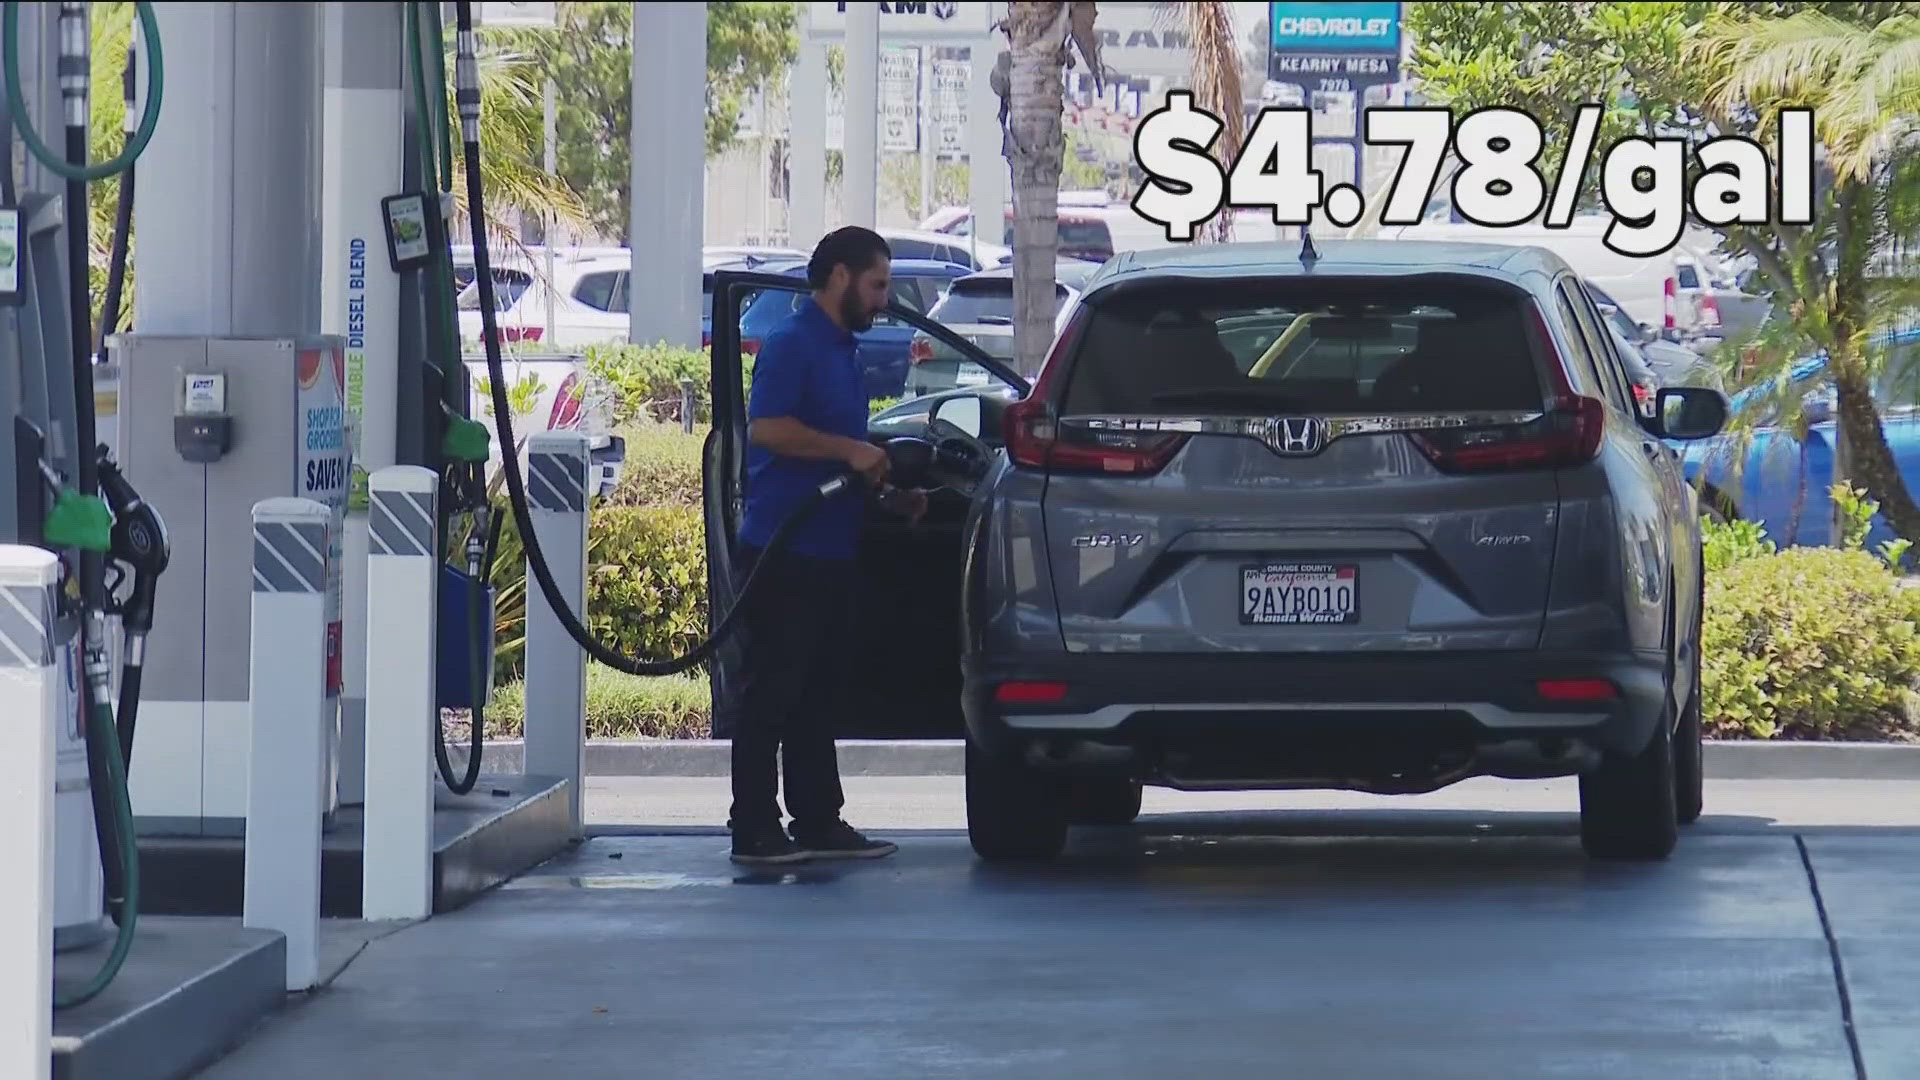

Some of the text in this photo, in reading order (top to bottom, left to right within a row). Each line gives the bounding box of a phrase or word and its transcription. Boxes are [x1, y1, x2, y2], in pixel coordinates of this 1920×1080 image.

[1280, 17, 1391, 36] CHEVROLET
[1093, 29, 1196, 48] RAM
[1280, 57, 1389, 73] KEARNY MESA
[350, 238, 365, 289] BLEND
[349, 295, 364, 349] DIESEL
[307, 407, 329, 429] SHOP
[306, 457, 336, 492] SAVE
[1072, 534, 1143, 547] CR-V
[1267, 564, 1333, 573] ORANGE COUNTY
[1247, 585, 1351, 614] 9AYB010
[1253, 612, 1298, 623] Honda
